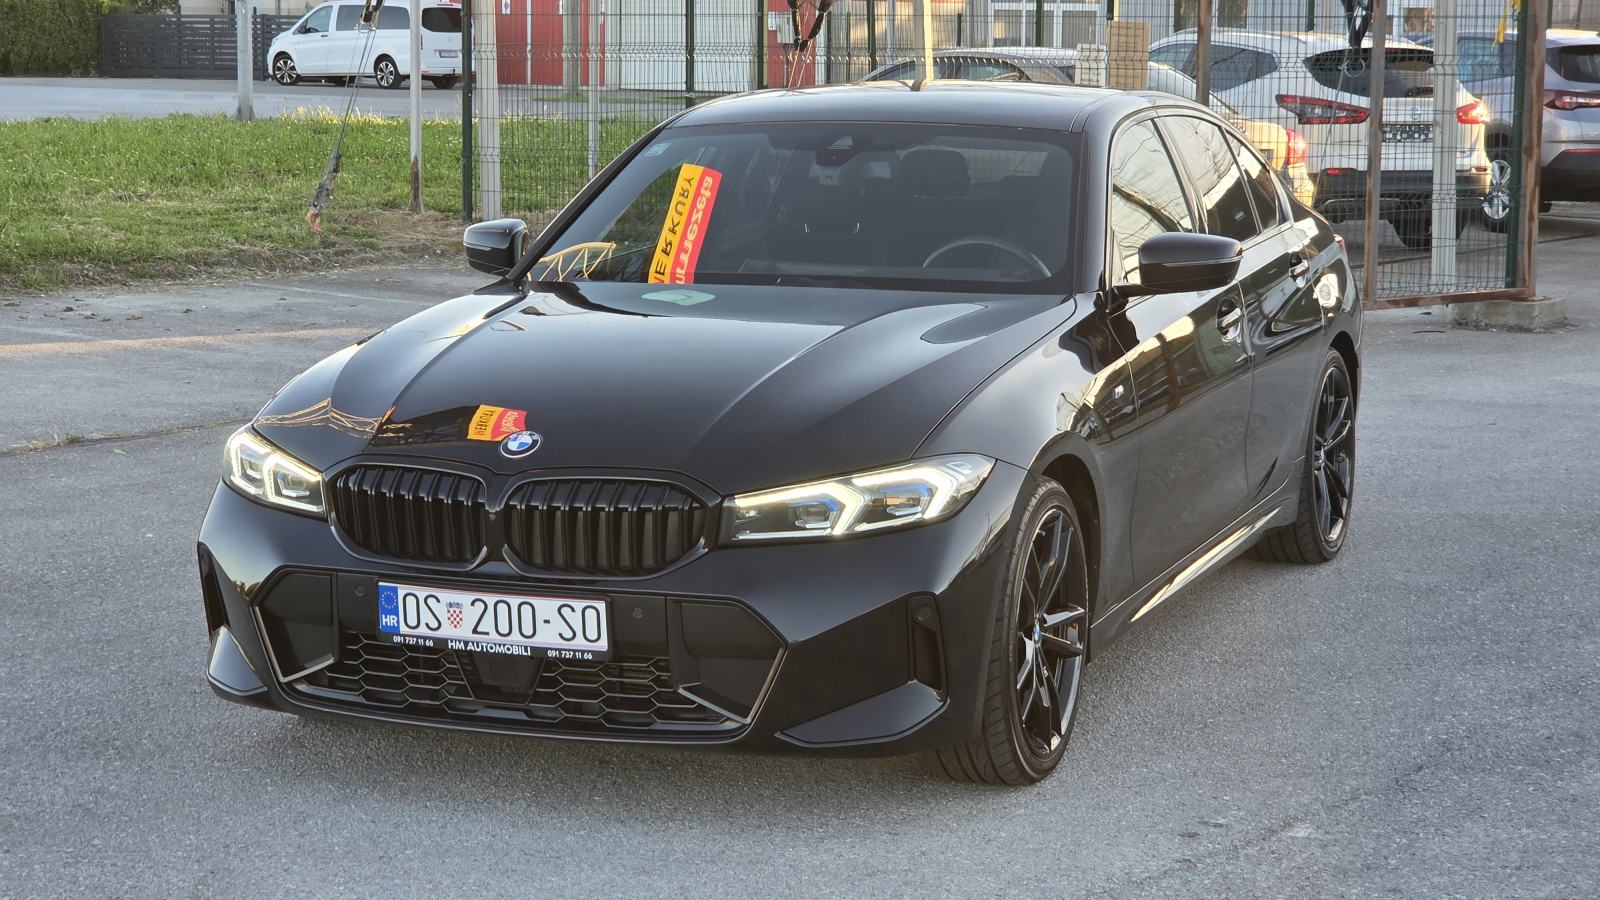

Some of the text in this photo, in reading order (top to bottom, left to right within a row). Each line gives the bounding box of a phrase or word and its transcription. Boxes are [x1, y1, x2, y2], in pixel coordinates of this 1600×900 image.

[382, 614, 398, 627] HR
[402, 592, 602, 643] OS 200-SO
[393, 635, 404, 643] 091
[405, 637, 416, 645] 737
[418, 638, 424, 646] 11
[448, 639, 531, 656] HM AUTOMOBILI
[547, 650, 593, 660] 091 737 11 66
